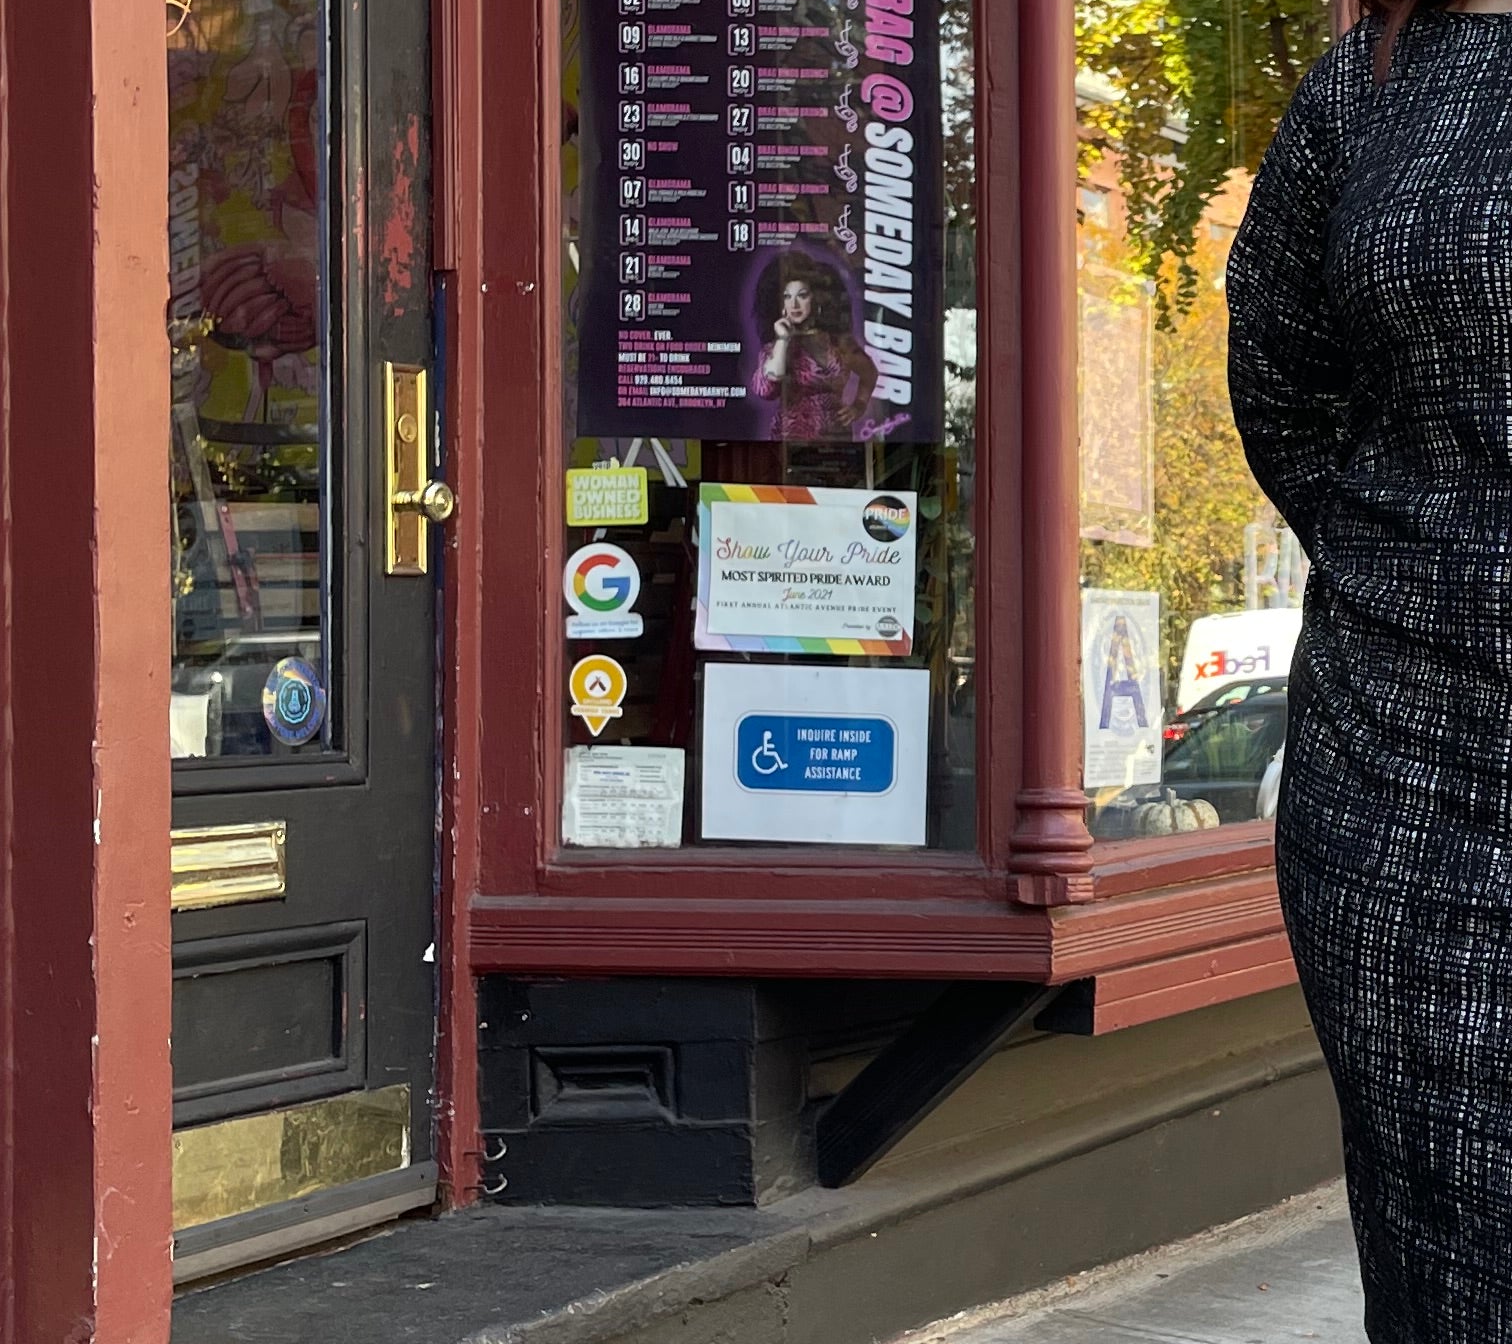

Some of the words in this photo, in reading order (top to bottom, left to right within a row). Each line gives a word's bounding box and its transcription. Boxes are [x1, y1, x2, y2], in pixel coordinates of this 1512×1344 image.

[623, 26, 640, 44] 09
[734, 28, 749, 46] 13
[624, 67, 639, 85] 16
[732, 69, 750, 88] 20
[860, 72, 914, 123] @
[623, 105, 640, 123] 23
[732, 109, 749, 126] 27
[623, 143, 640, 161] 30
[732, 147, 749, 165] 04
[624, 180, 641, 198] 07
[734, 185, 748, 203] 11
[625, 219, 640, 236] 14
[864, 122, 913, 319] SOMEDAY
[734, 224, 748, 242] 18
[625, 256, 640, 274] 21
[624, 294, 641, 311] 28
[864, 319, 912, 406] BAR
[574, 474, 640, 489] WOMAN
[574, 489, 641, 505] OWNED
[574, 504, 641, 519] BUSINESS
[864, 508, 907, 521] PRIDE
[716, 536, 771, 561] Show
[777, 539, 833, 568] Your
[840, 541, 902, 565] Pride
[721, 570, 756, 582] MOST
[757, 571, 808, 584] SPIRITED
[810, 573, 844, 585] PRIDE
[844, 574, 891, 587] AWARD
[782, 587, 805, 602] June
[807, 589, 833, 600] 2021
[815, 604, 845, 612] AVENUE
[1099, 616, 1149, 729] A
[797, 728, 836, 742] INQUIRE
[839, 730, 871, 743] INSIDE
[810, 747, 828, 760] FOR
[831, 748, 858, 761] RAMP
[804, 766, 861, 780] ASSISTANCE
